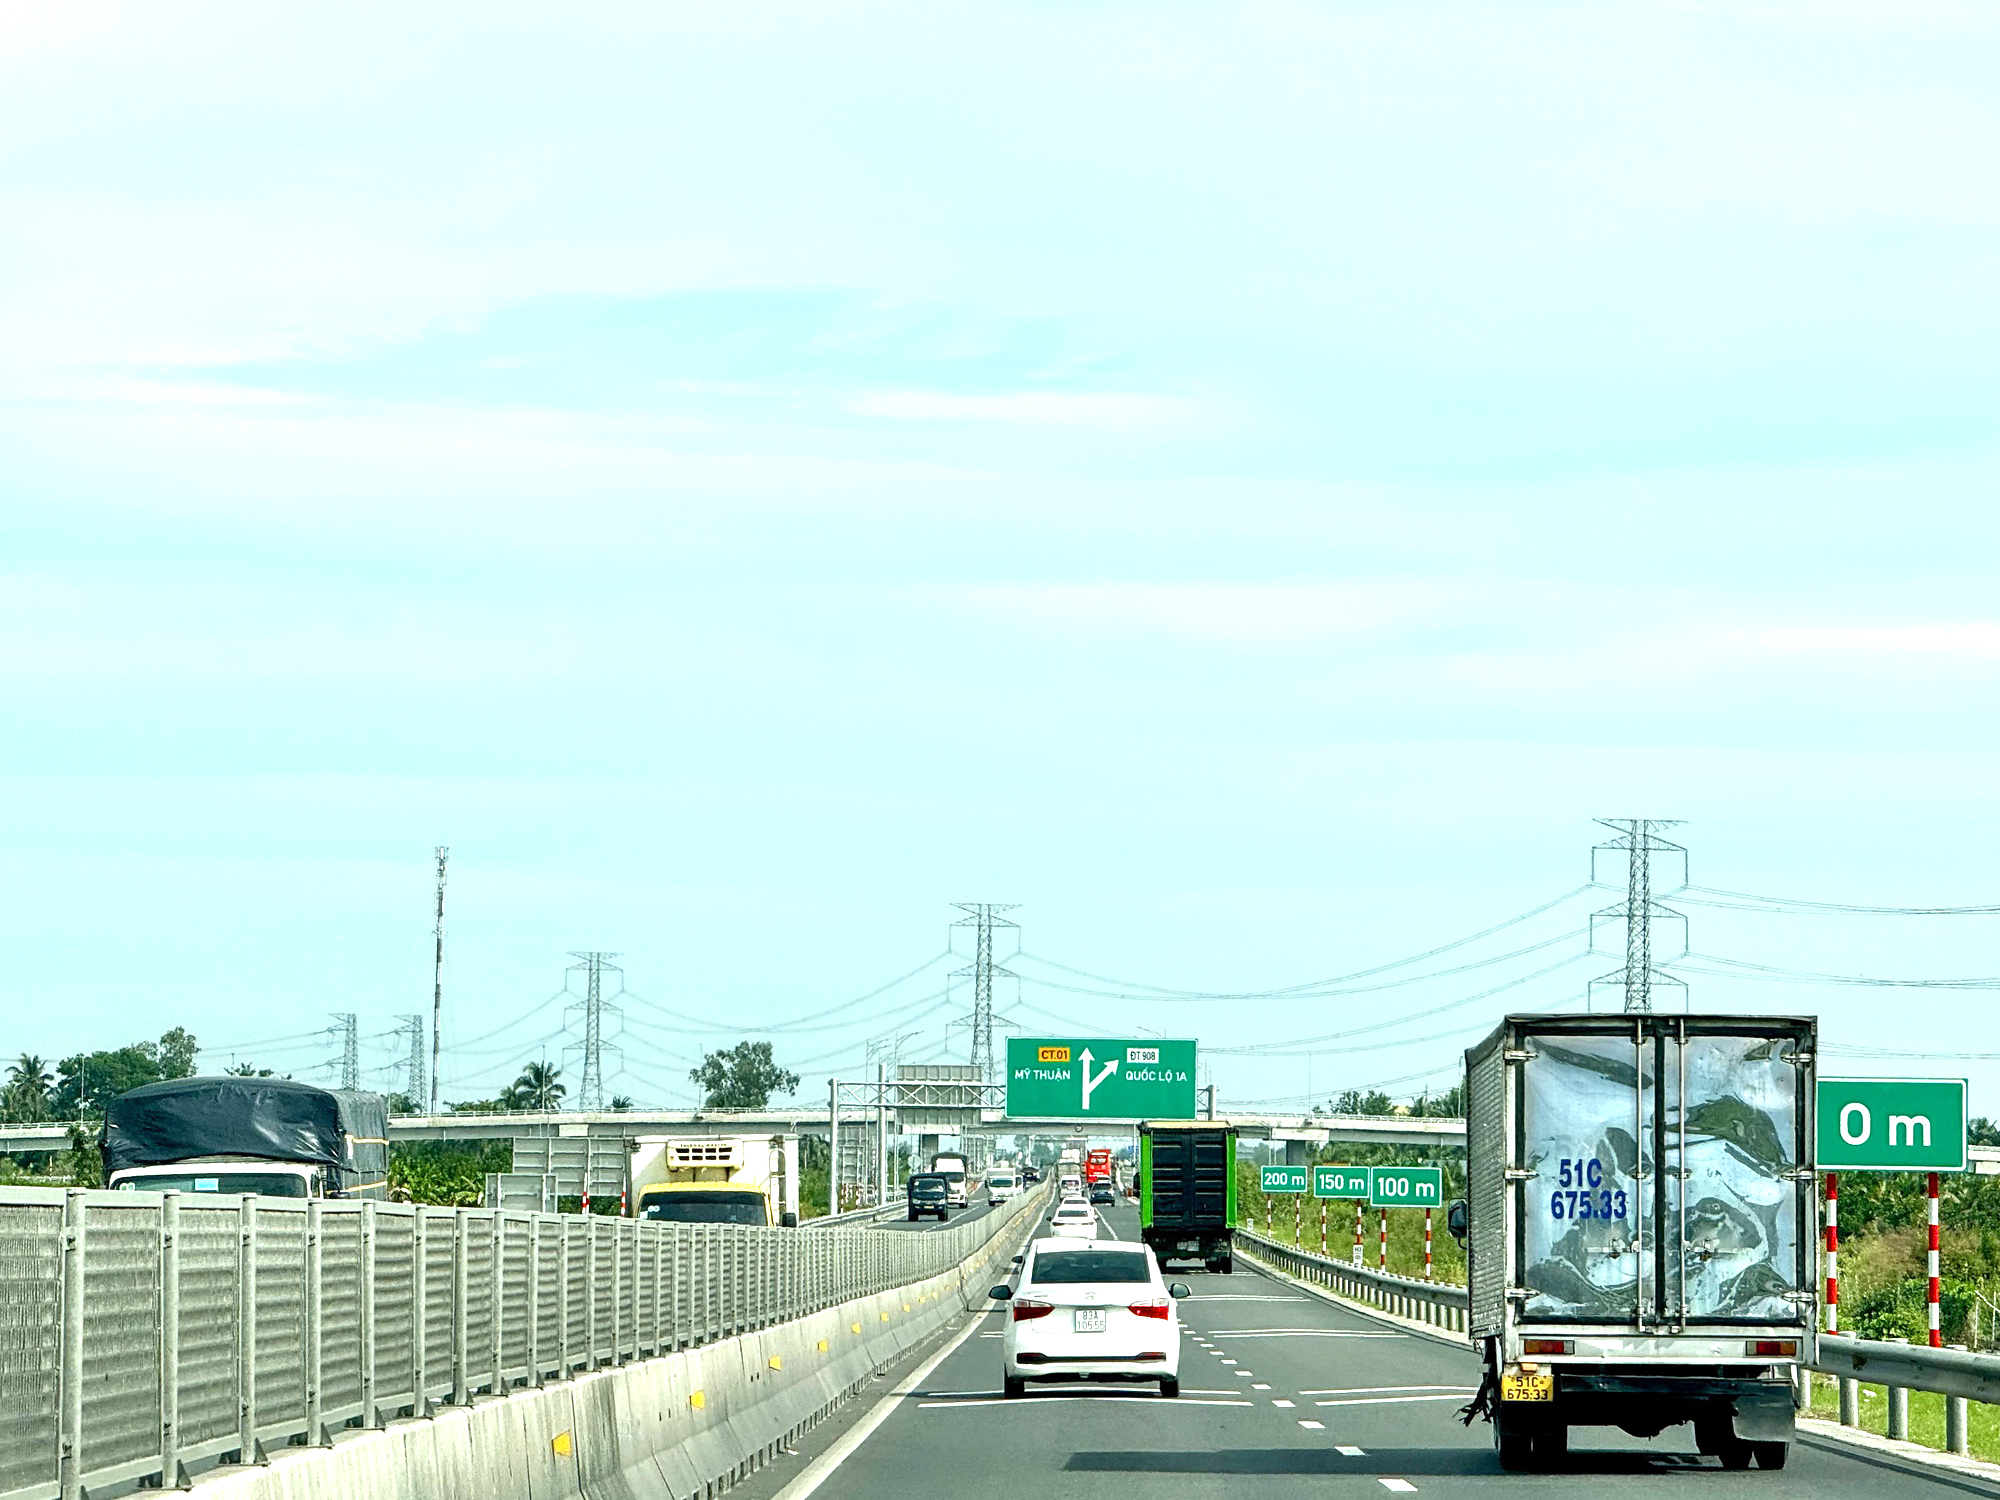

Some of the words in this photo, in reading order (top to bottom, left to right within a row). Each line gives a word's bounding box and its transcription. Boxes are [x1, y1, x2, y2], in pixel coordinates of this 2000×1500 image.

[1041, 1050, 1068, 1060] CT.01
[1130, 1051, 1156, 1060] ĐT.908
[1014, 1068, 1030, 1080] MỸ
[1034, 1068, 1071, 1082] THUẬN
[1126, 1067, 1156, 1082] QUỐC
[1158, 1069, 1172, 1083] LỘ
[1176, 1071, 1188, 1082] 1A
[1838, 1102, 1872, 1146] 0
[1888, 1114, 1932, 1147] m
[1264, 1172, 1288, 1186] 200
[1291, 1175, 1304, 1186] m
[1559, 1158, 1602, 1188] 51C
[1318, 1174, 1344, 1190] 150
[1349, 1178, 1364, 1190] m
[1378, 1177, 1409, 1197] 100
[1415, 1182, 1435, 1198] m
[1551, 1190, 1627, 1220] 675.33
[1082, 1310, 1098, 1320] 83A
[1516, 1376, 1538, 1388] 51C
